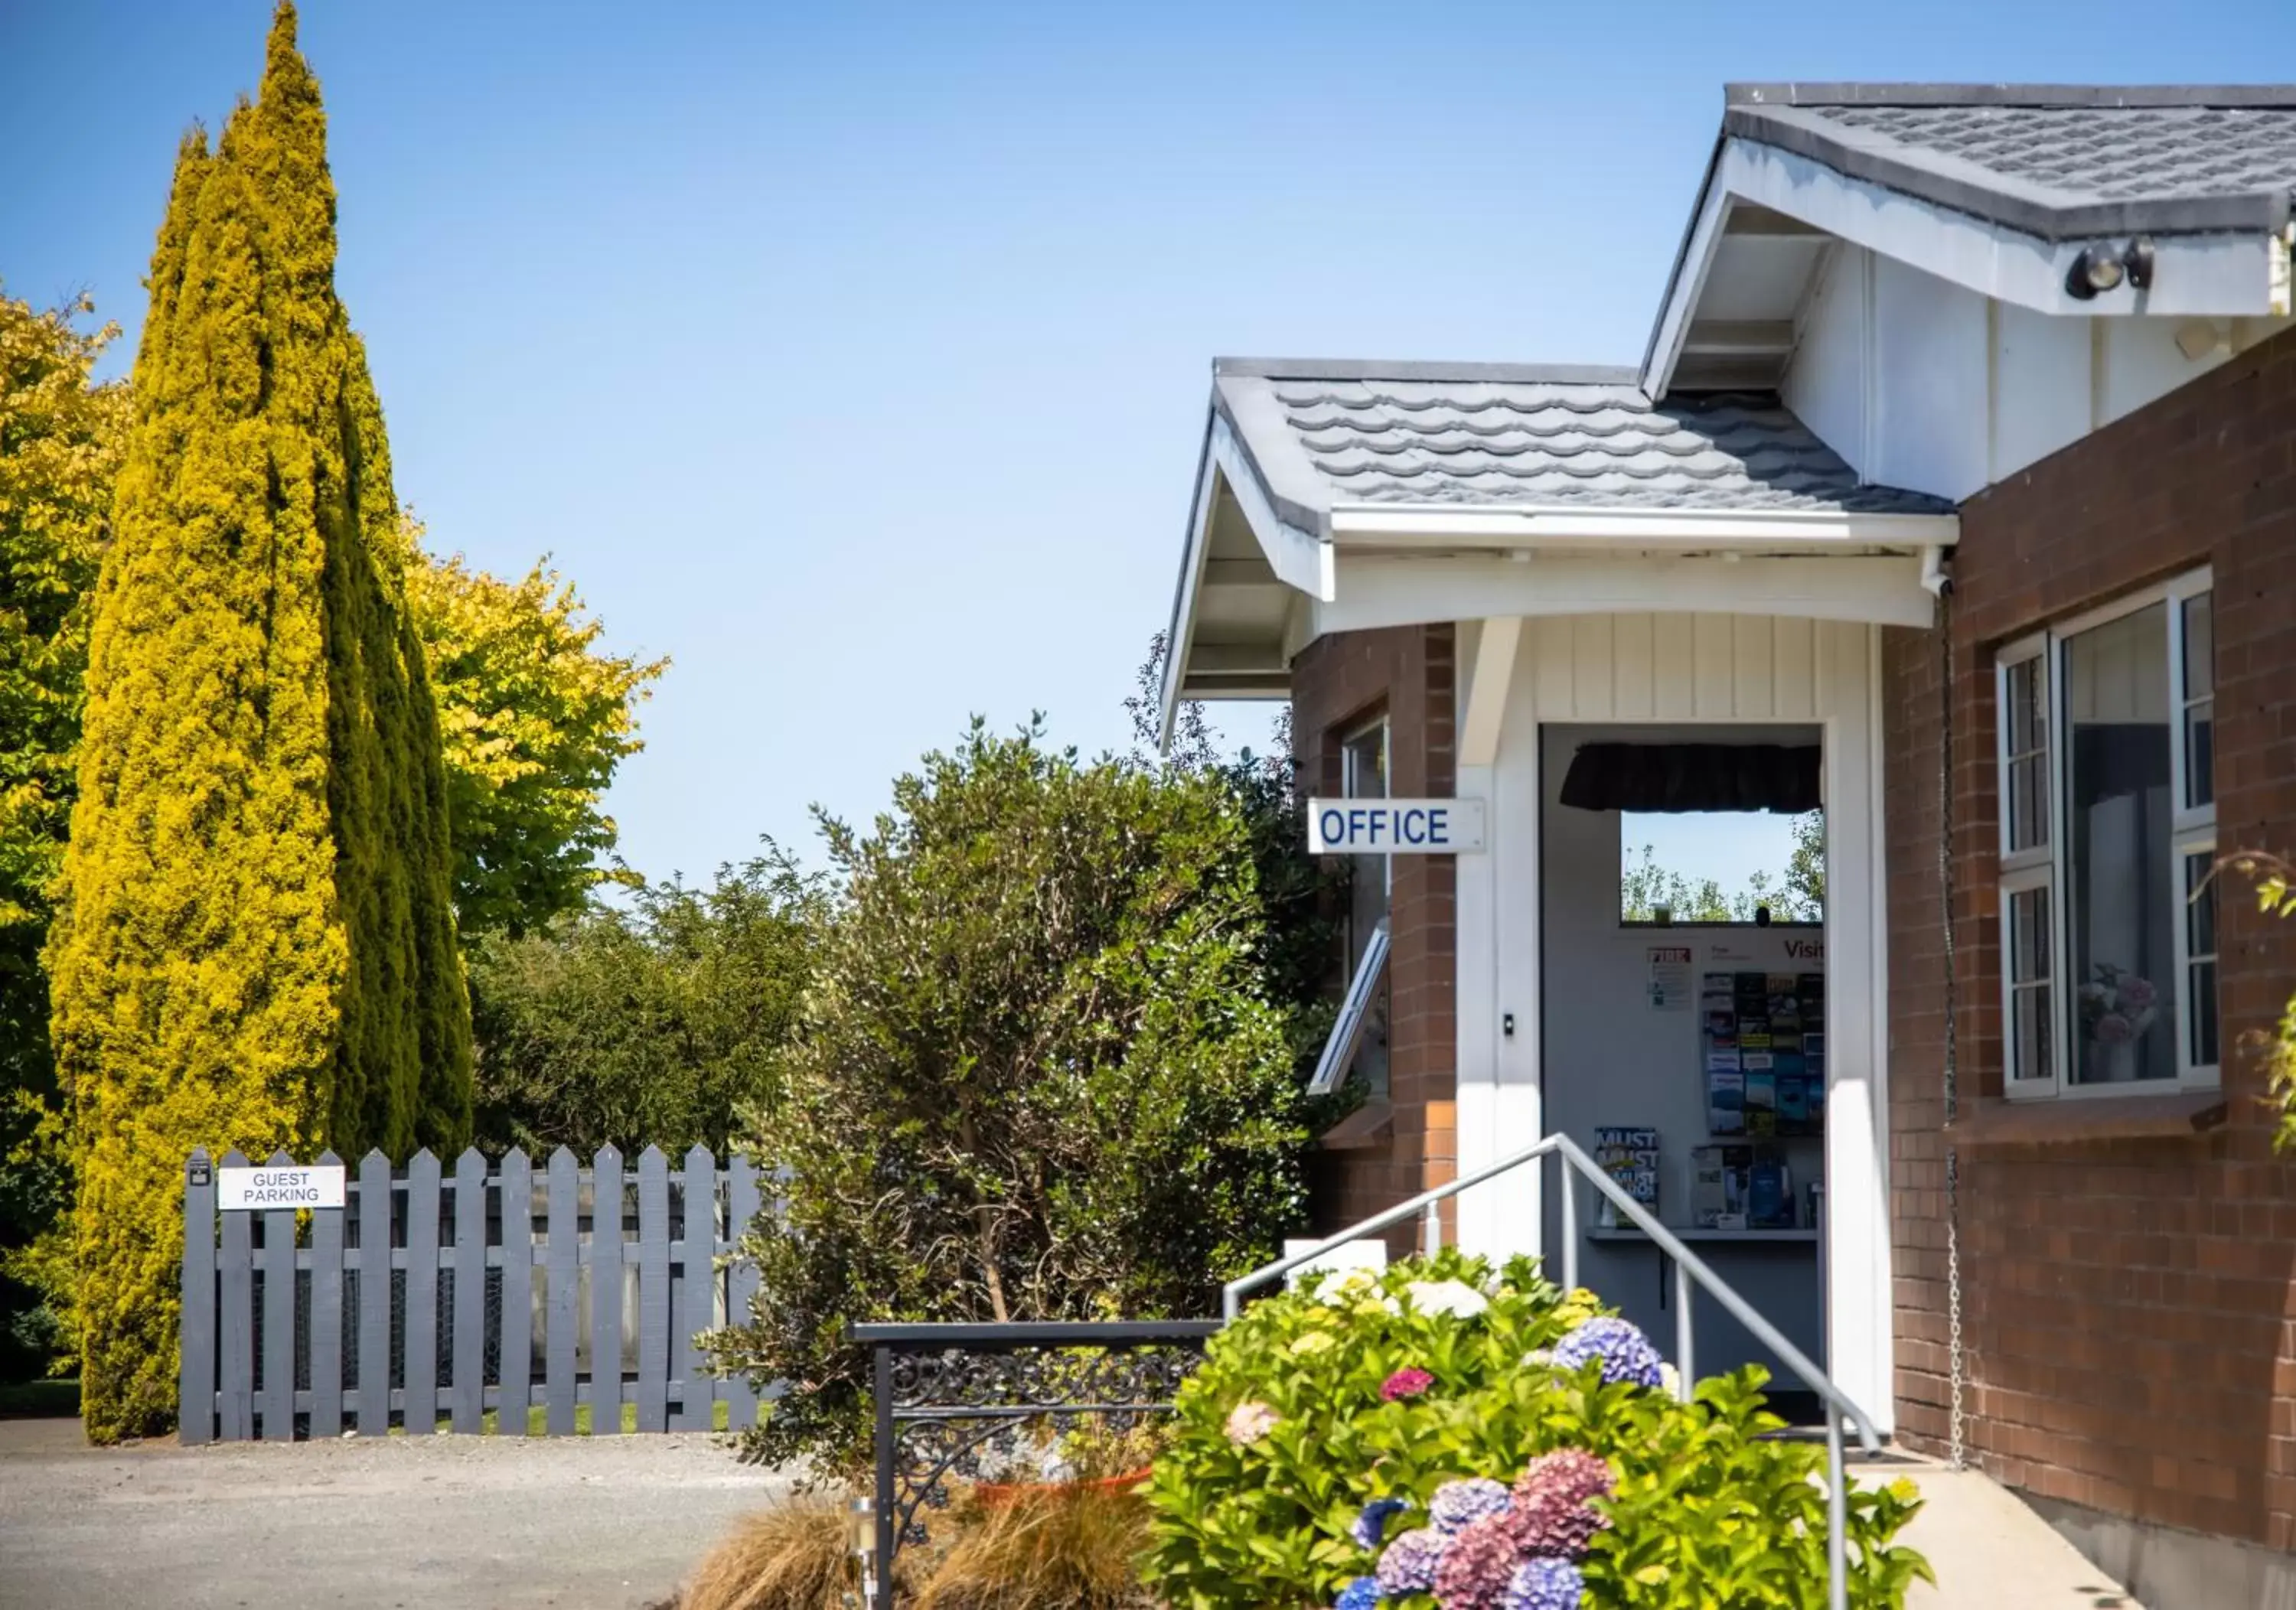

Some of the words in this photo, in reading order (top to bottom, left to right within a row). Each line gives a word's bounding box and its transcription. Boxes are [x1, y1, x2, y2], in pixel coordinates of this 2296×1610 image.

[1320, 808, 1449, 845] OFFICE
[1596, 1133, 1655, 1148] MUST
[253, 1172, 310, 1187] GUEST
[243, 1188, 319, 1203] PARKING
